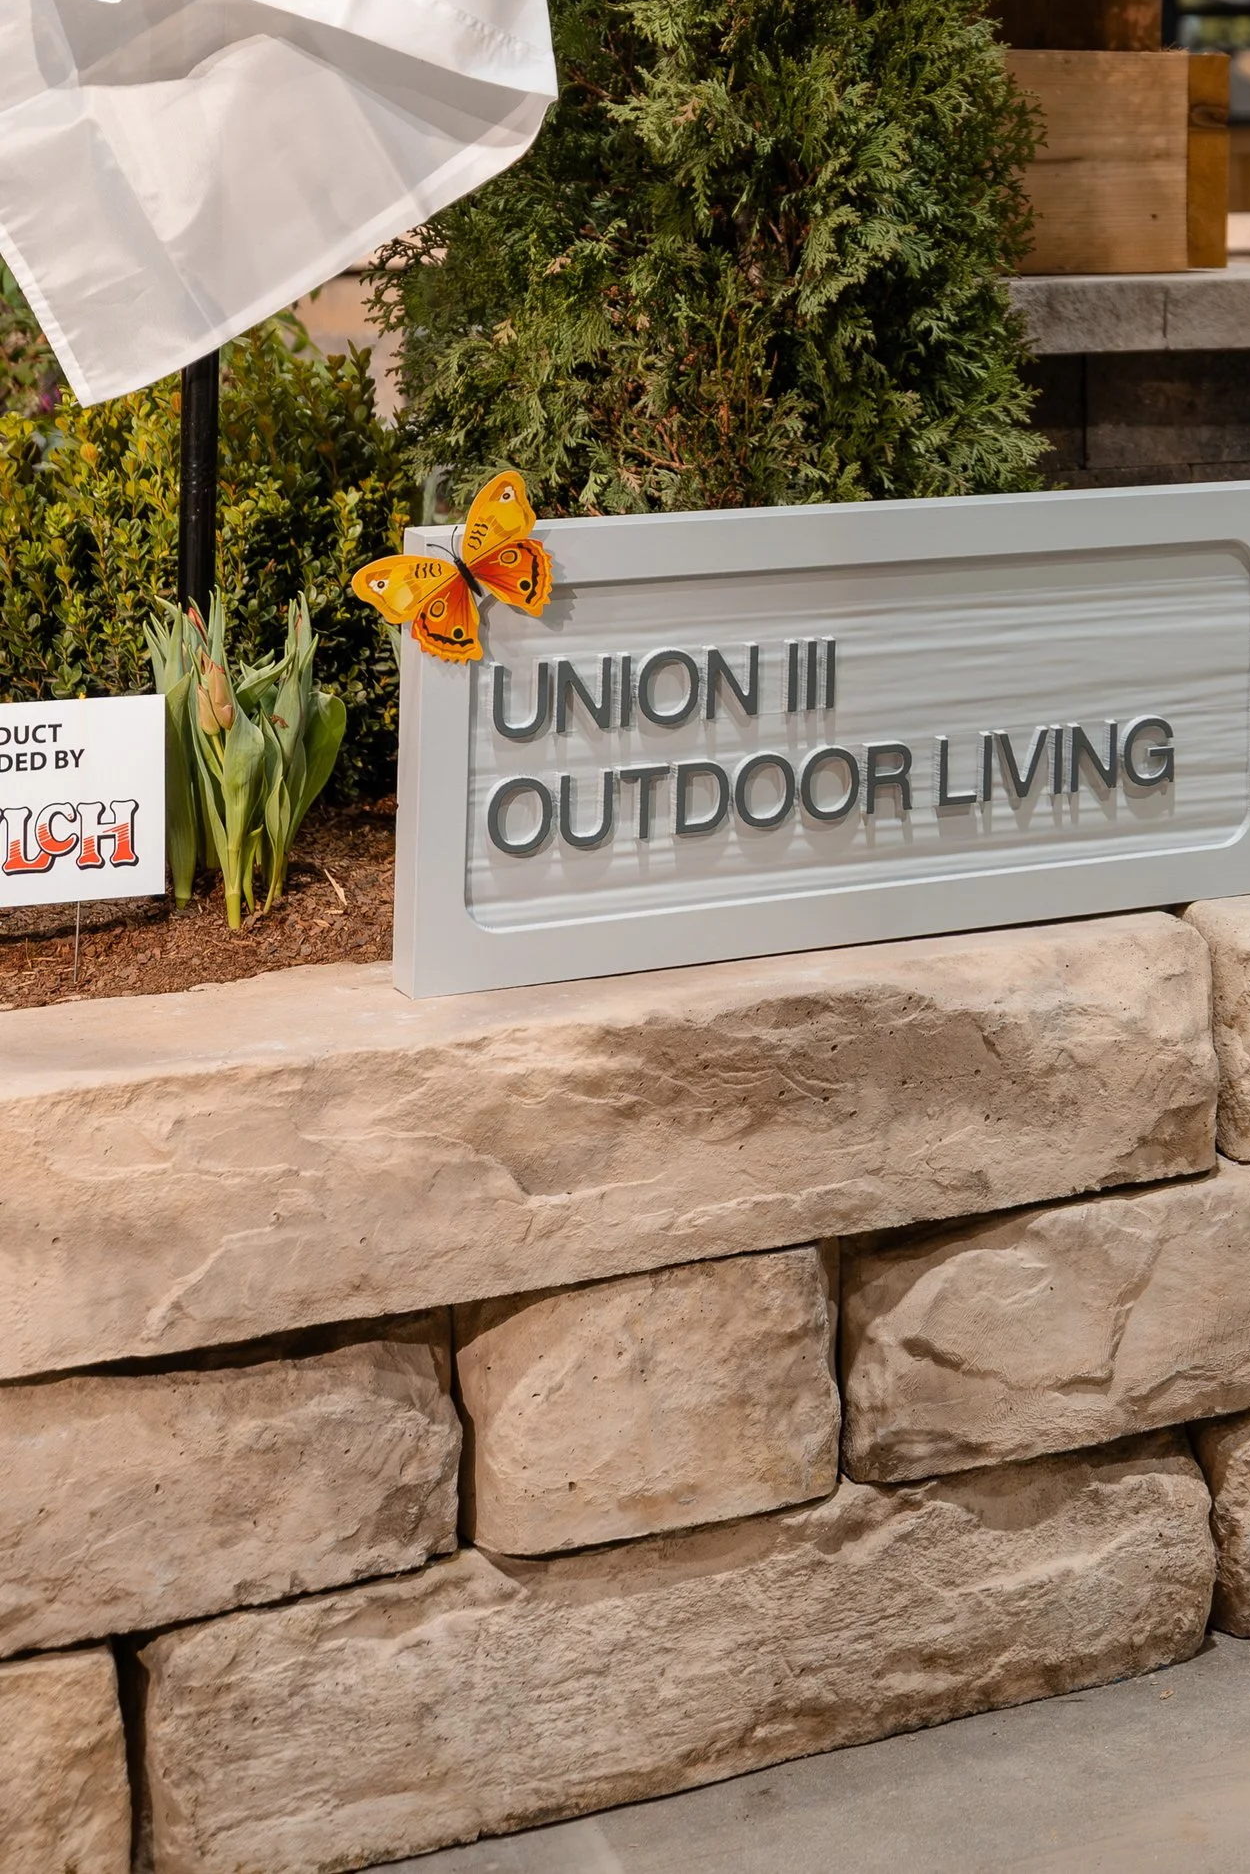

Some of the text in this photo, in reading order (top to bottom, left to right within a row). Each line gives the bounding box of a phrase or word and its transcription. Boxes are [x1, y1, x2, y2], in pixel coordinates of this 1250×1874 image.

[490, 635, 837, 740] UNION III
[54, 748, 86, 770] BY
[486, 714, 1176, 856] OUTDOOR LIVING
[0, 798, 140, 877] LCH
